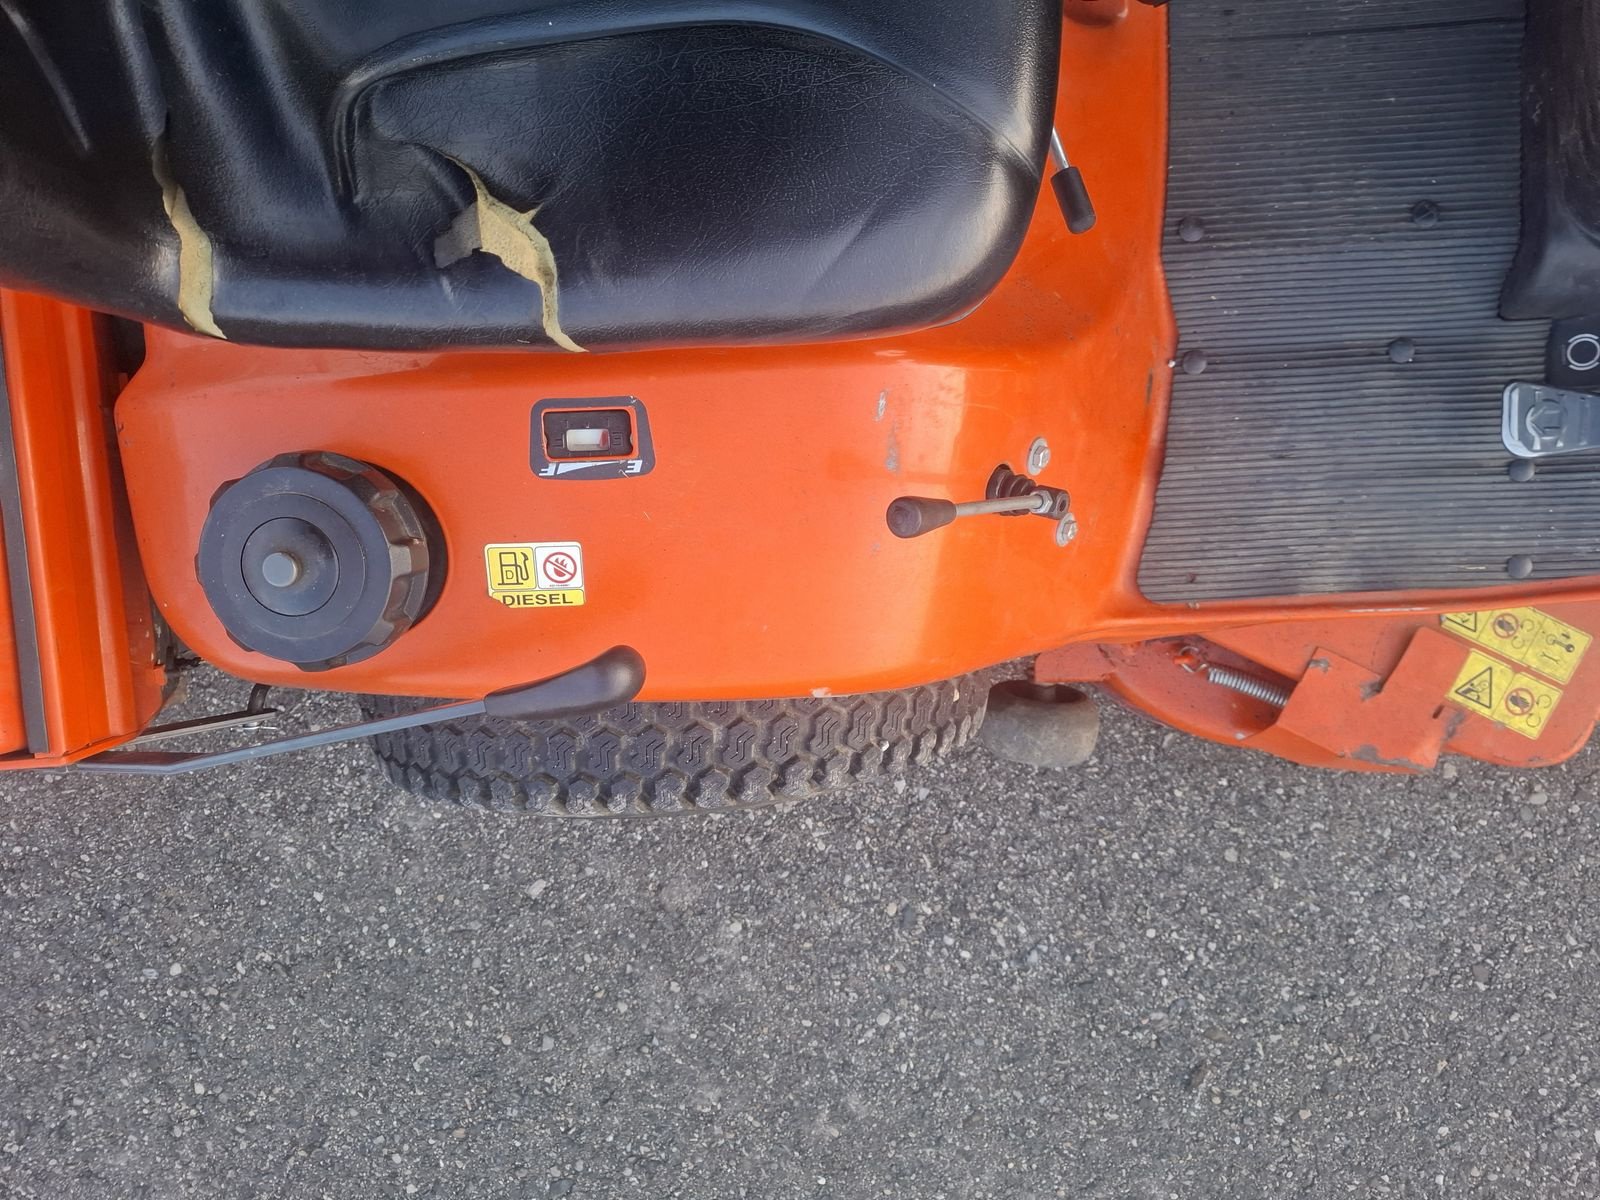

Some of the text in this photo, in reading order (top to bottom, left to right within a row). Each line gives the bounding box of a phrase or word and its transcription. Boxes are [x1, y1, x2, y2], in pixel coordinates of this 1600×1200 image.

[538, 460, 643, 477] E F
[505, 570, 514, 579] D
[502, 593, 574, 606] DIESEL
